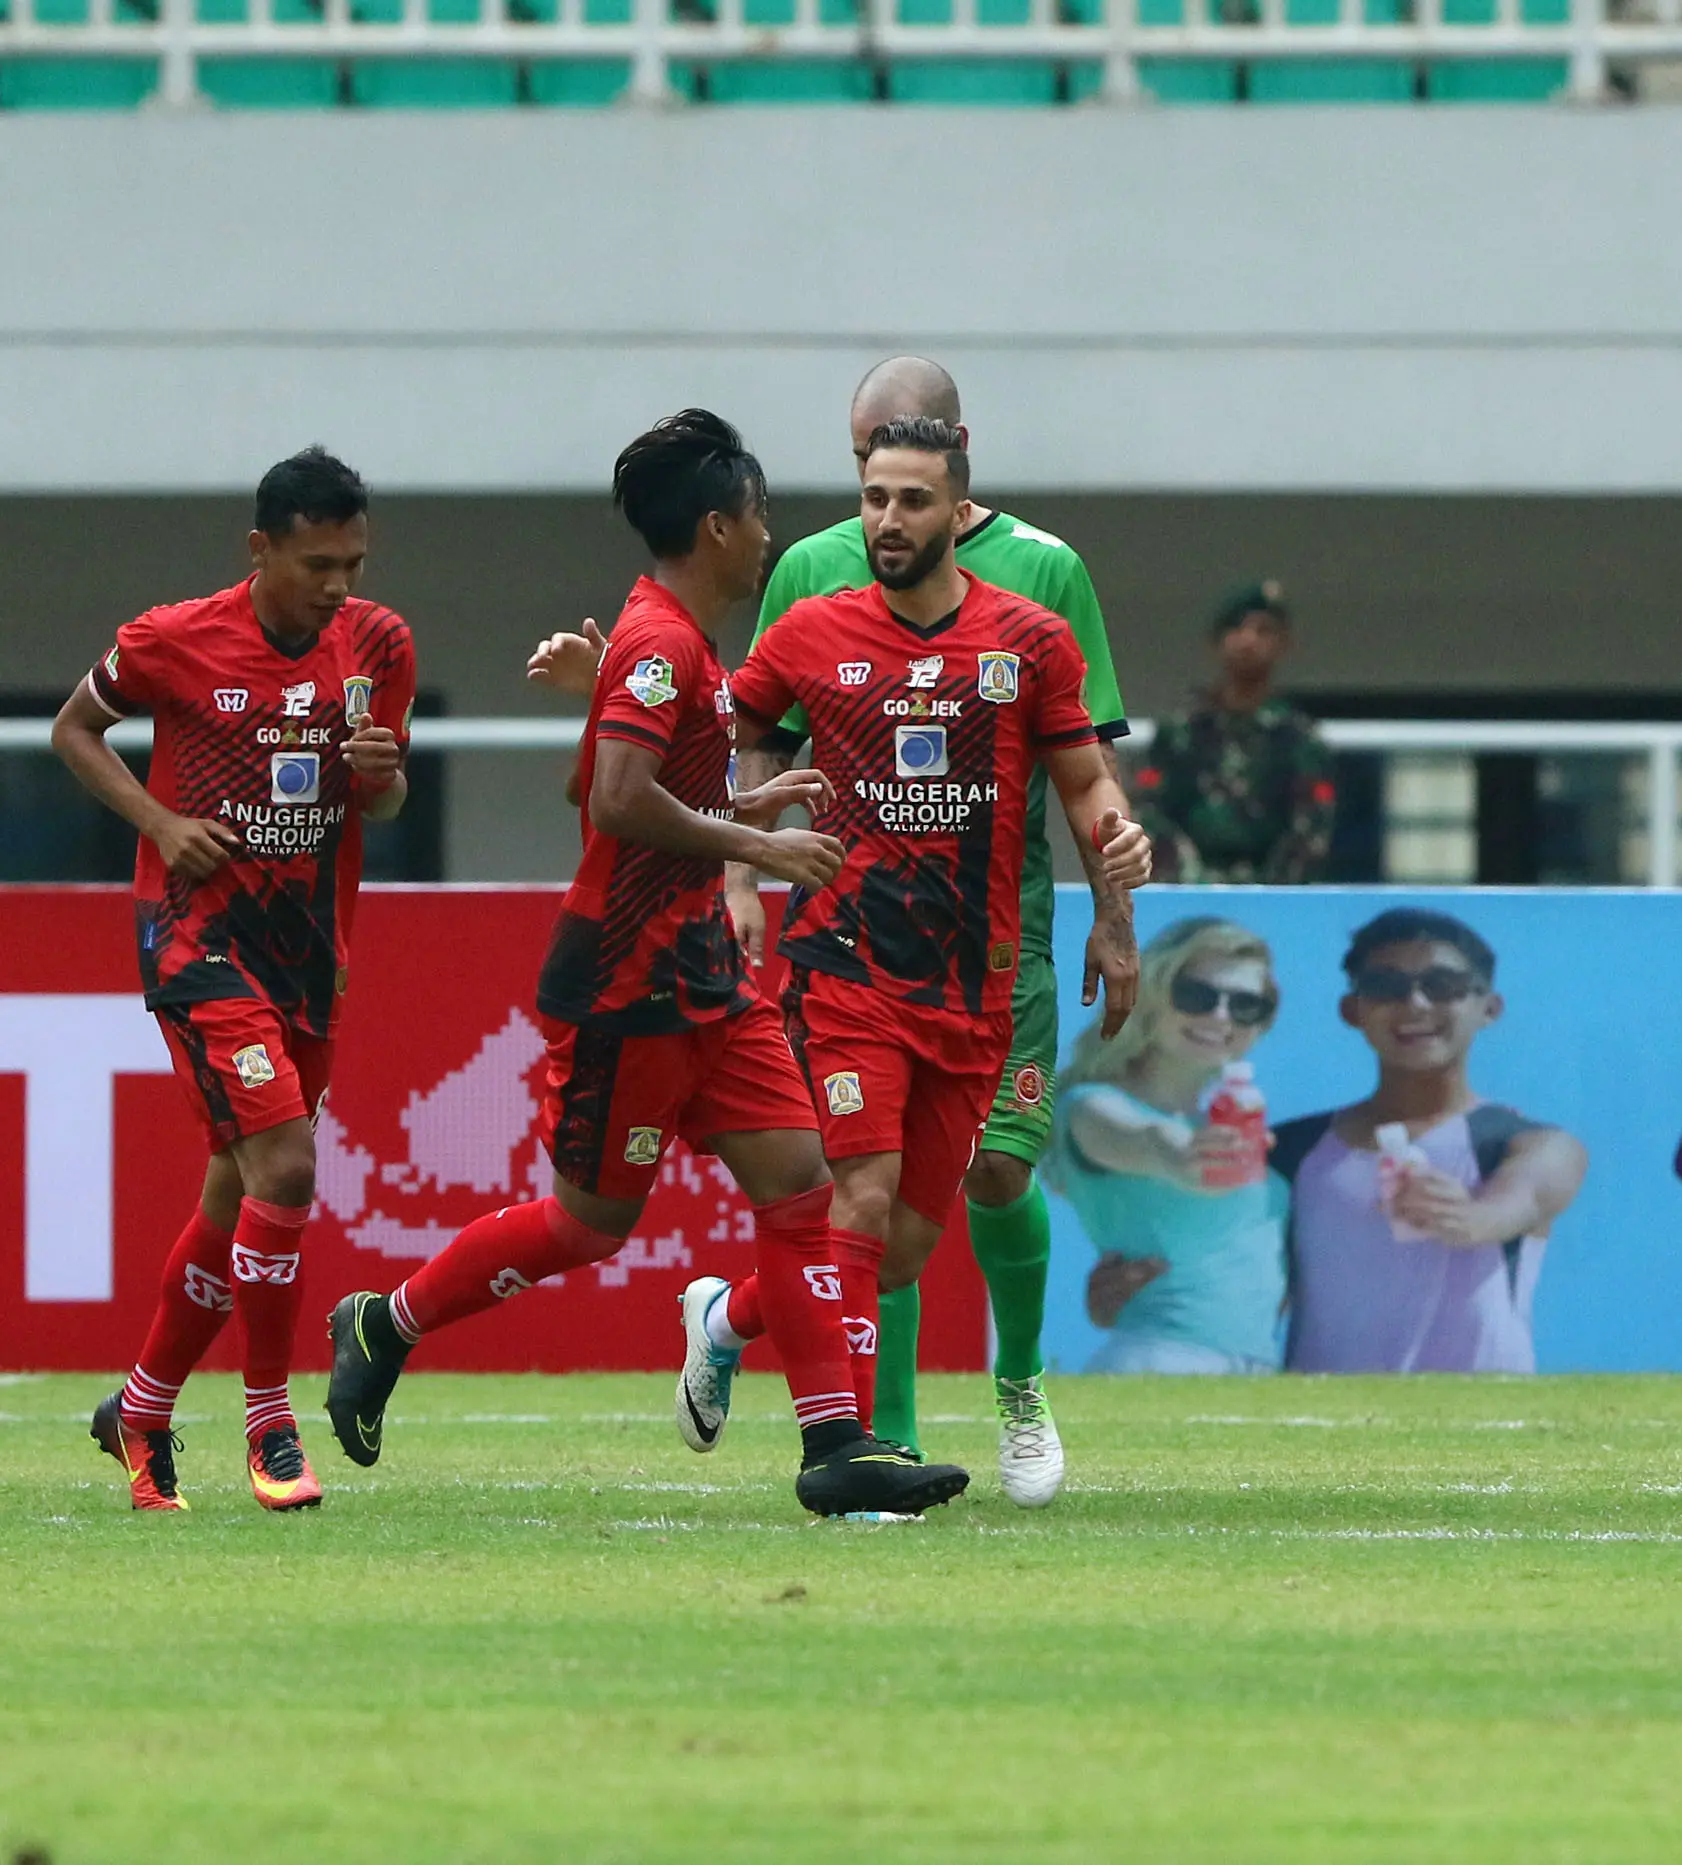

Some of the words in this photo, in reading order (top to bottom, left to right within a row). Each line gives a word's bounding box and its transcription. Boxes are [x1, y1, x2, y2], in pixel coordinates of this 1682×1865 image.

[855, 779, 999, 803] ANUGERAH
[219, 799, 346, 827] ANUGERAH
[878, 803, 970, 824] GROUP
[246, 825, 326, 846] GROUP
